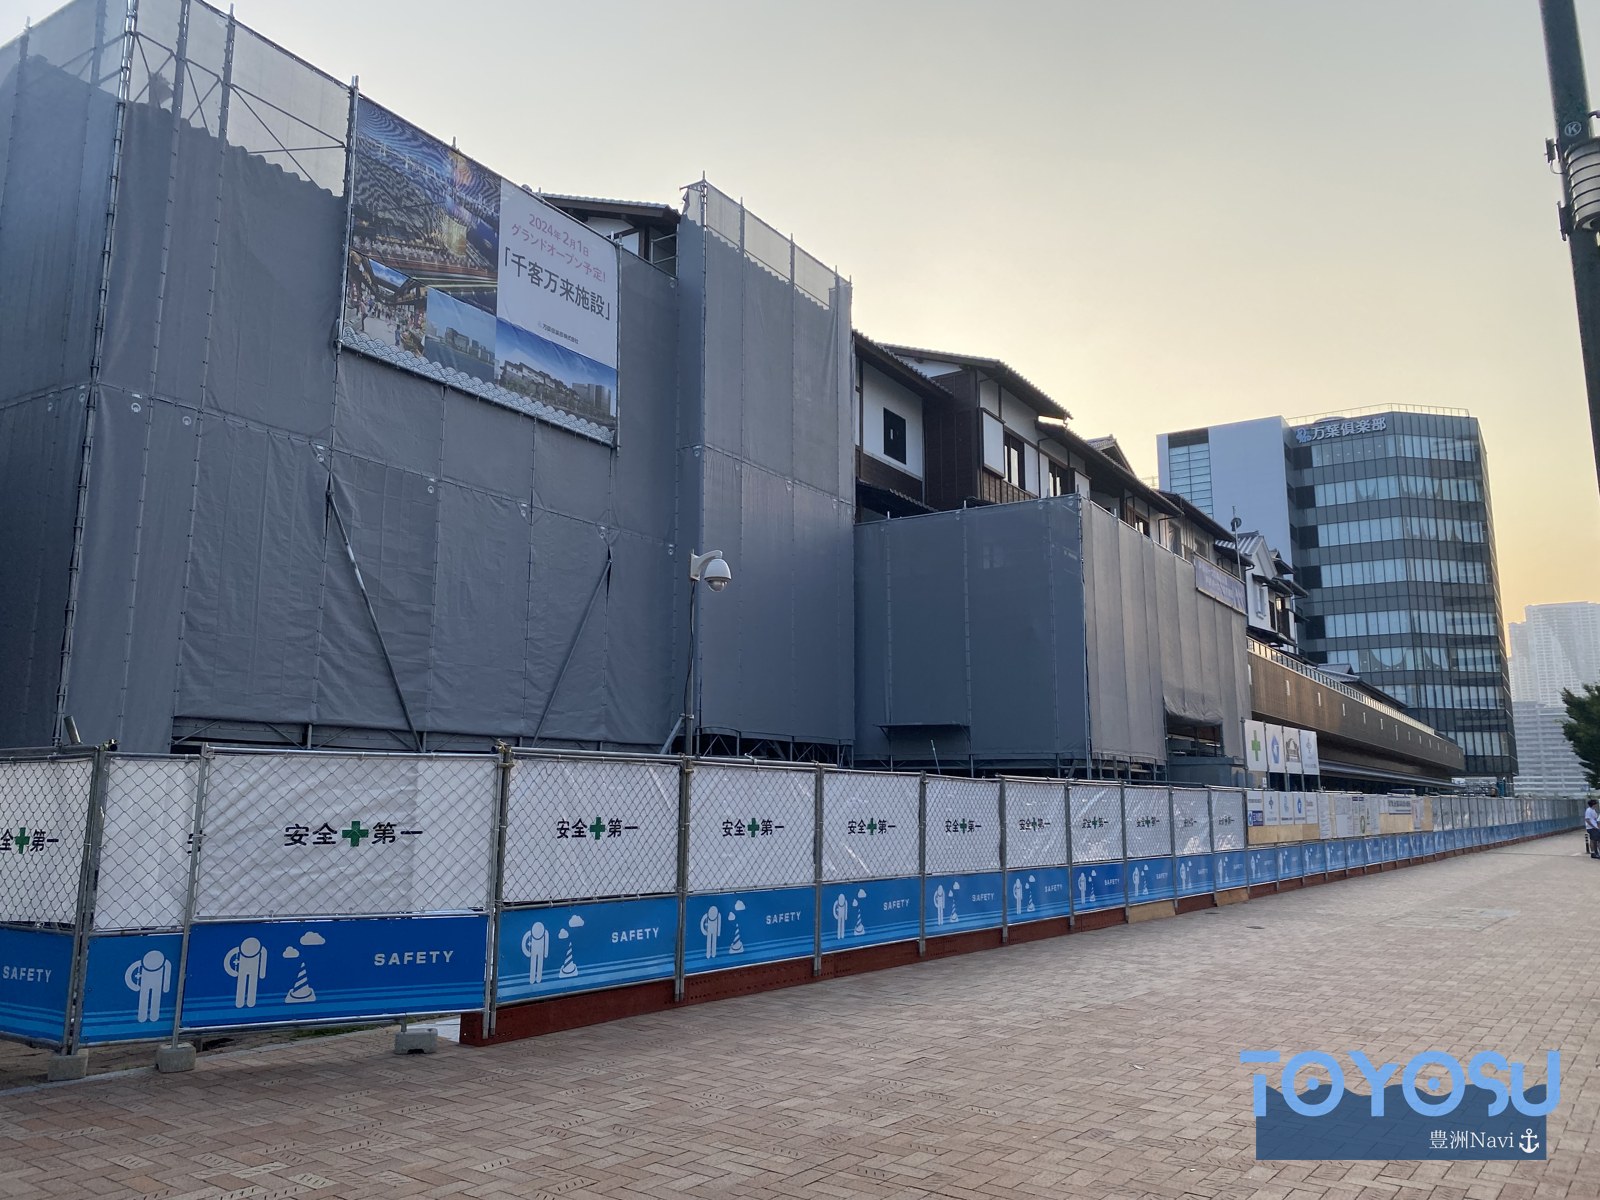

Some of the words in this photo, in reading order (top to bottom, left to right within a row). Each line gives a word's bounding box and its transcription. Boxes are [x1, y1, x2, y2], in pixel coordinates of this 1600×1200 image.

[529, 213, 590, 257] 2024年2月1日
[504, 246, 611, 321] 「千客万来施設」
[284, 822, 338, 847] 安全
[371, 822, 423, 845] 第一
[556, 818, 587, 840] 安全
[607, 818, 638, 838] 第一
[722, 819, 746, 837] 安全
[760, 819, 785, 836] 第一
[847, 819, 866, 835] 安全
[877, 818, 896, 834] 第一
[30, 828, 59, 853] 第一
[883, 899, 910, 911] SAFETY
[972, 893, 995, 902] SAFETY
[765, 911, 802, 925] SAFETY
[611, 927, 659, 944] SAFETY
[374, 950, 454, 967] SAFETY
[3, 966, 52, 983] SAFETY
